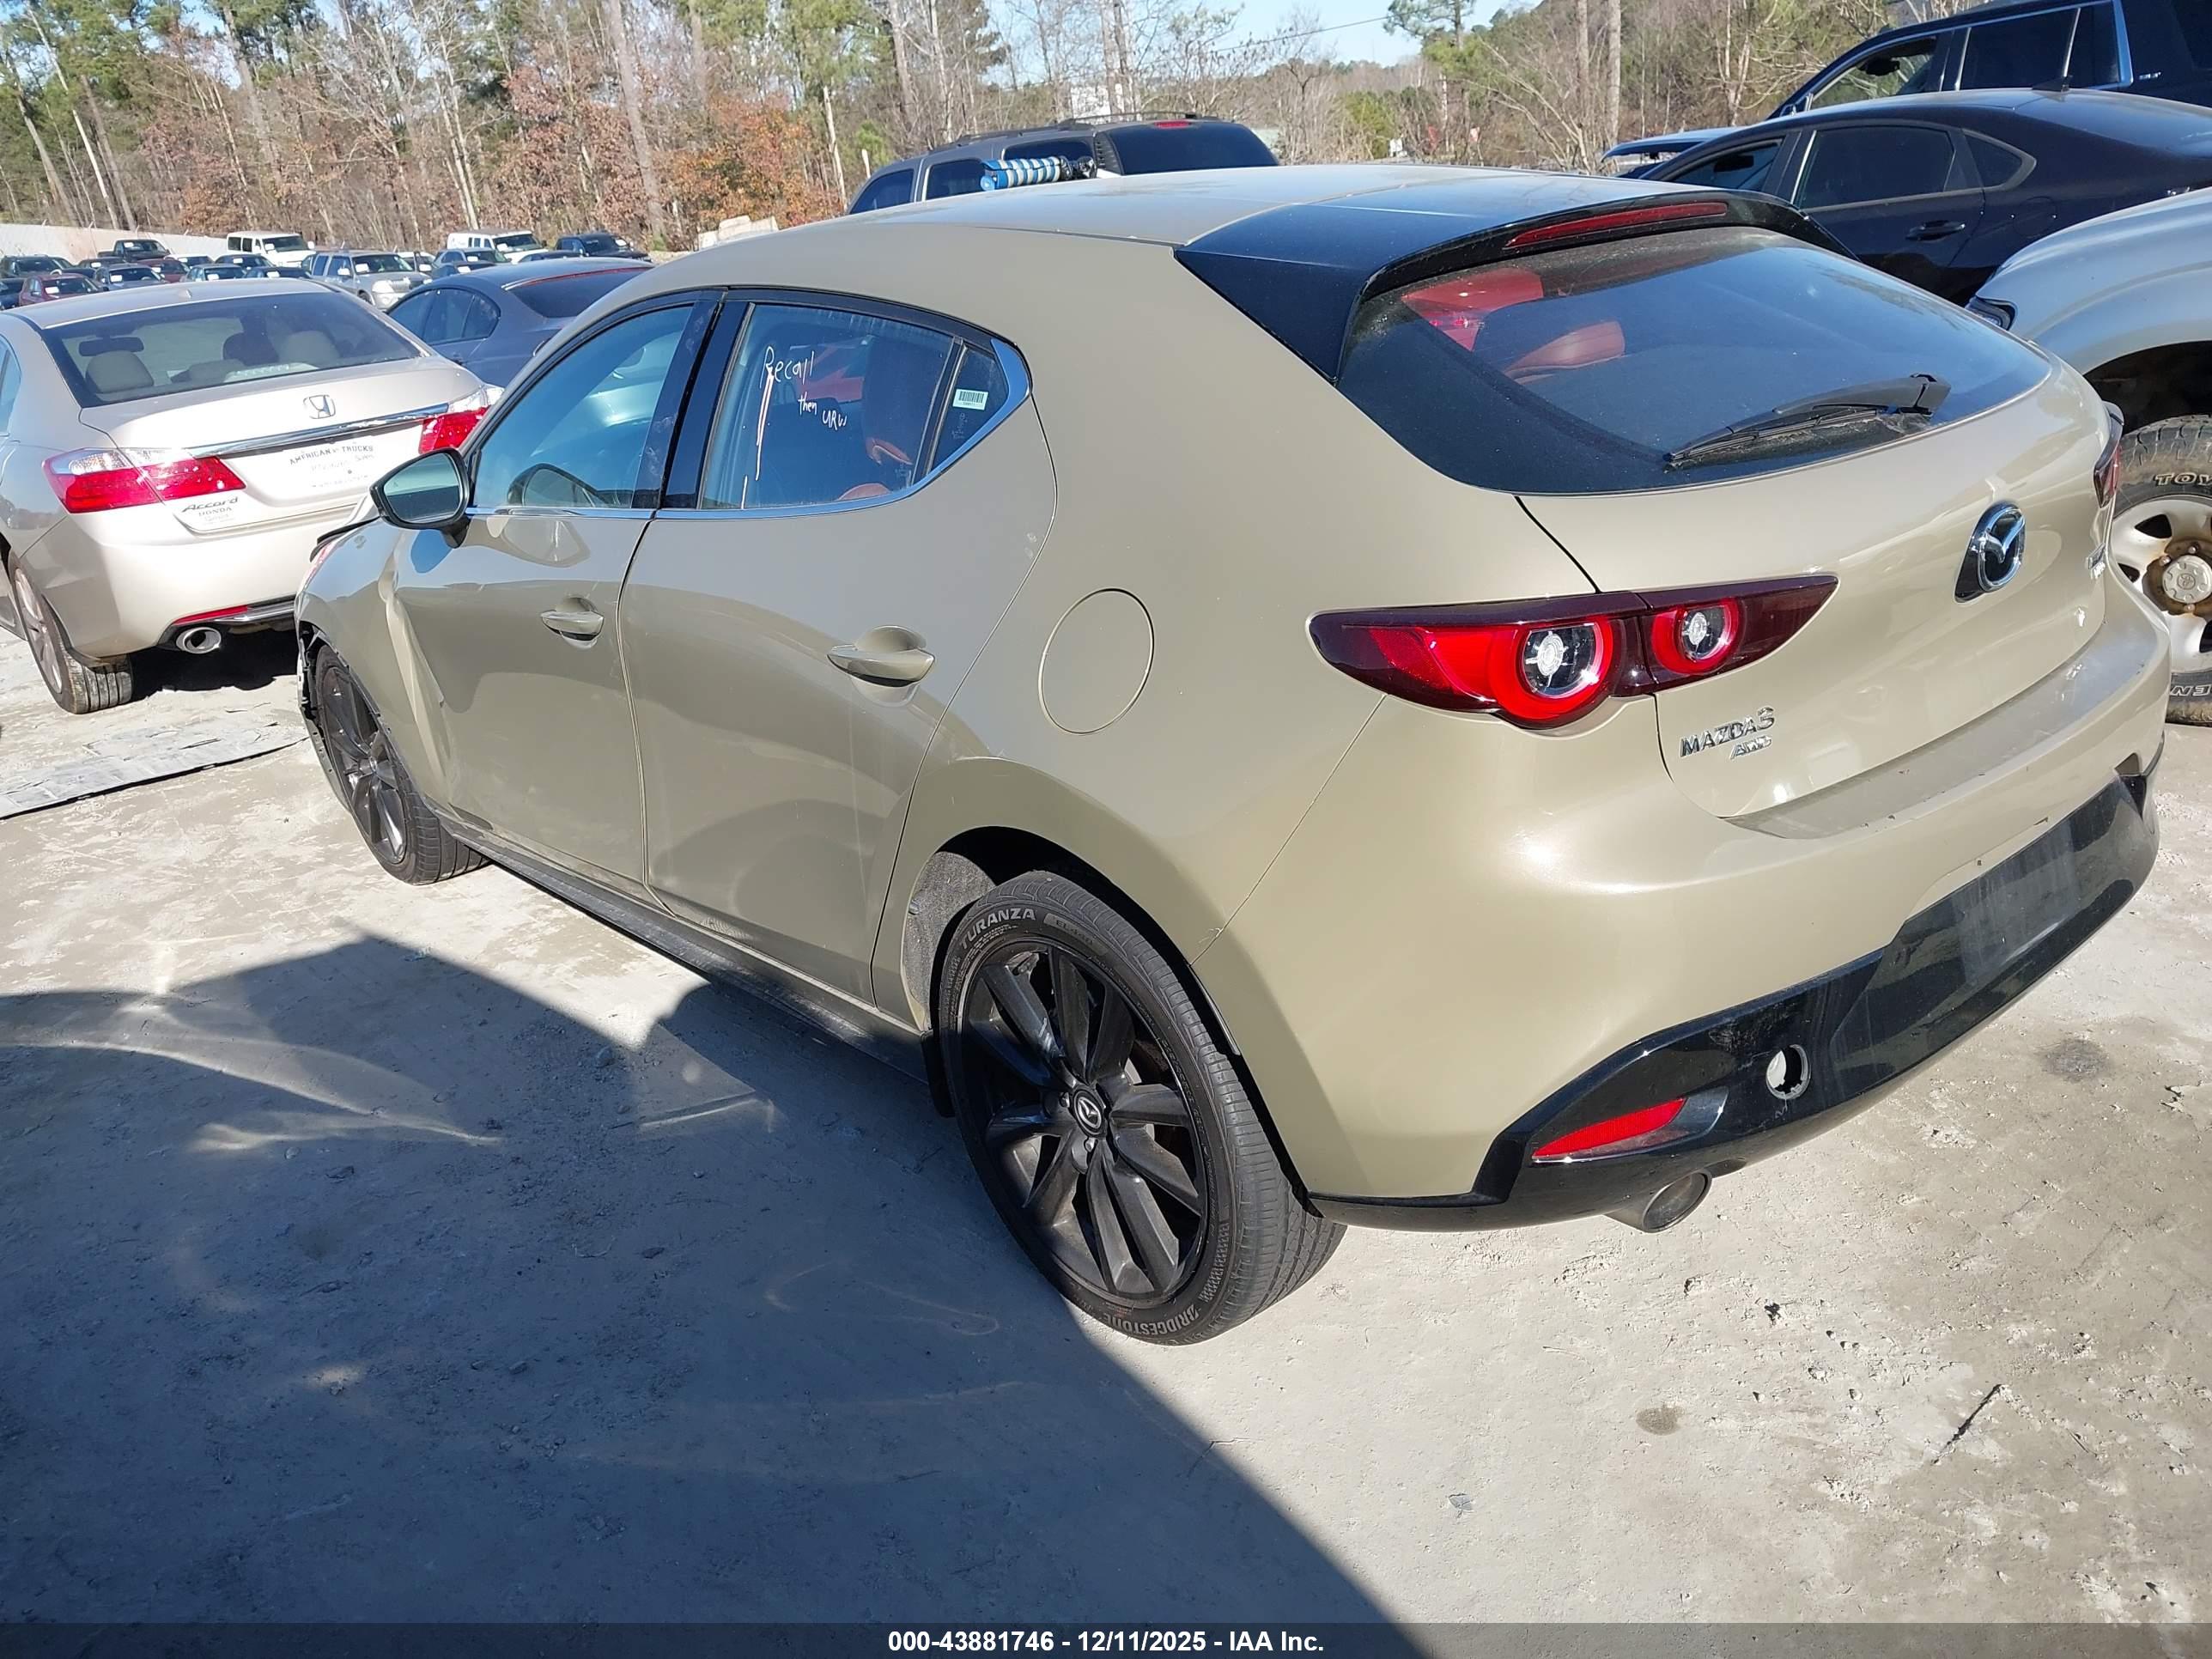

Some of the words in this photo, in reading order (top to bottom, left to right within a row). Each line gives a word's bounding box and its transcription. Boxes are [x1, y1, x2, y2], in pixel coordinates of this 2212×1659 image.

[759, 345, 815, 389] Recall
[797, 391, 818, 416] then
[289, 448, 331, 465] AMERICAN
[342, 445, 374, 453] TRUCKS
[181, 496, 239, 513] Accord
[198, 507, 233, 517] HONDA
[959, 908, 1036, 950] TURANZA
[1103, 1303, 1200, 1336] BRIDGESTONE
